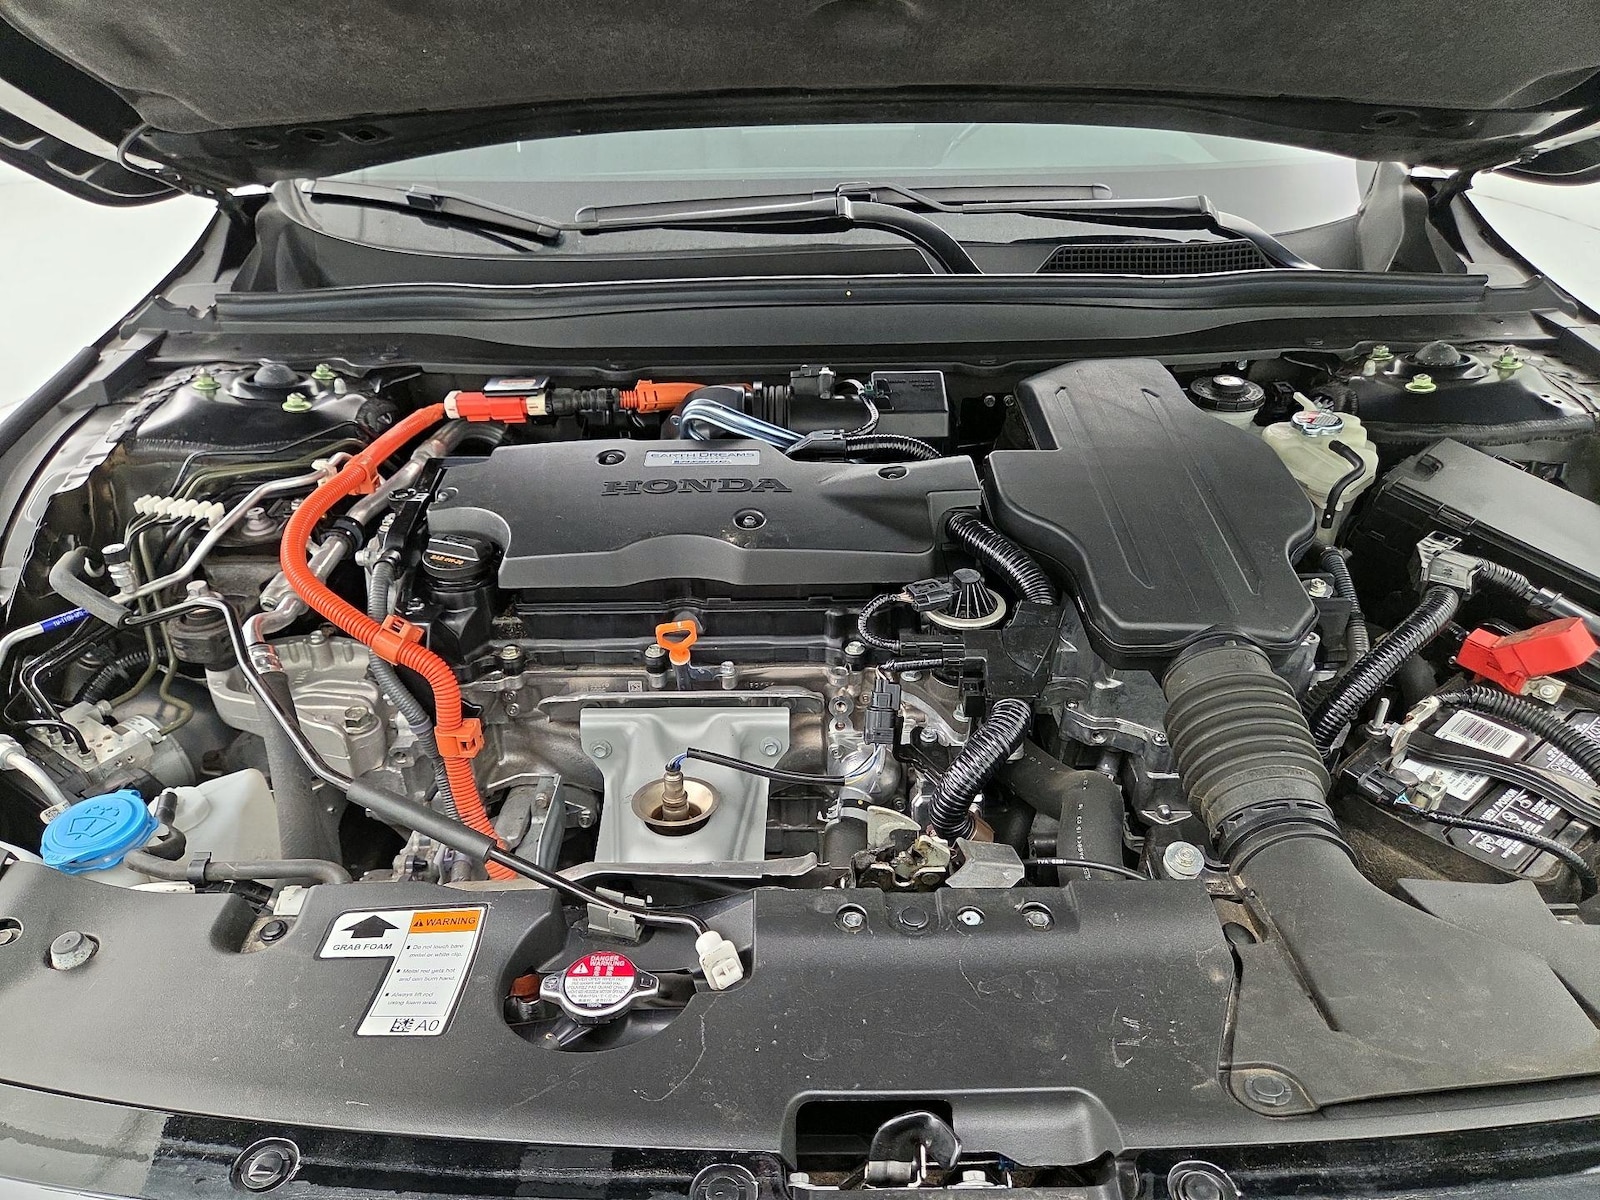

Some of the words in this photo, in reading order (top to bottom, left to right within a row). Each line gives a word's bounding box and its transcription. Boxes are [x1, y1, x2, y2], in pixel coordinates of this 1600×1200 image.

[601, 478, 793, 496] HONDA
[1495, 788, 1519, 808] POISON
[426, 916, 476, 926] WARNING
[414, 1020, 440, 1032] A0
